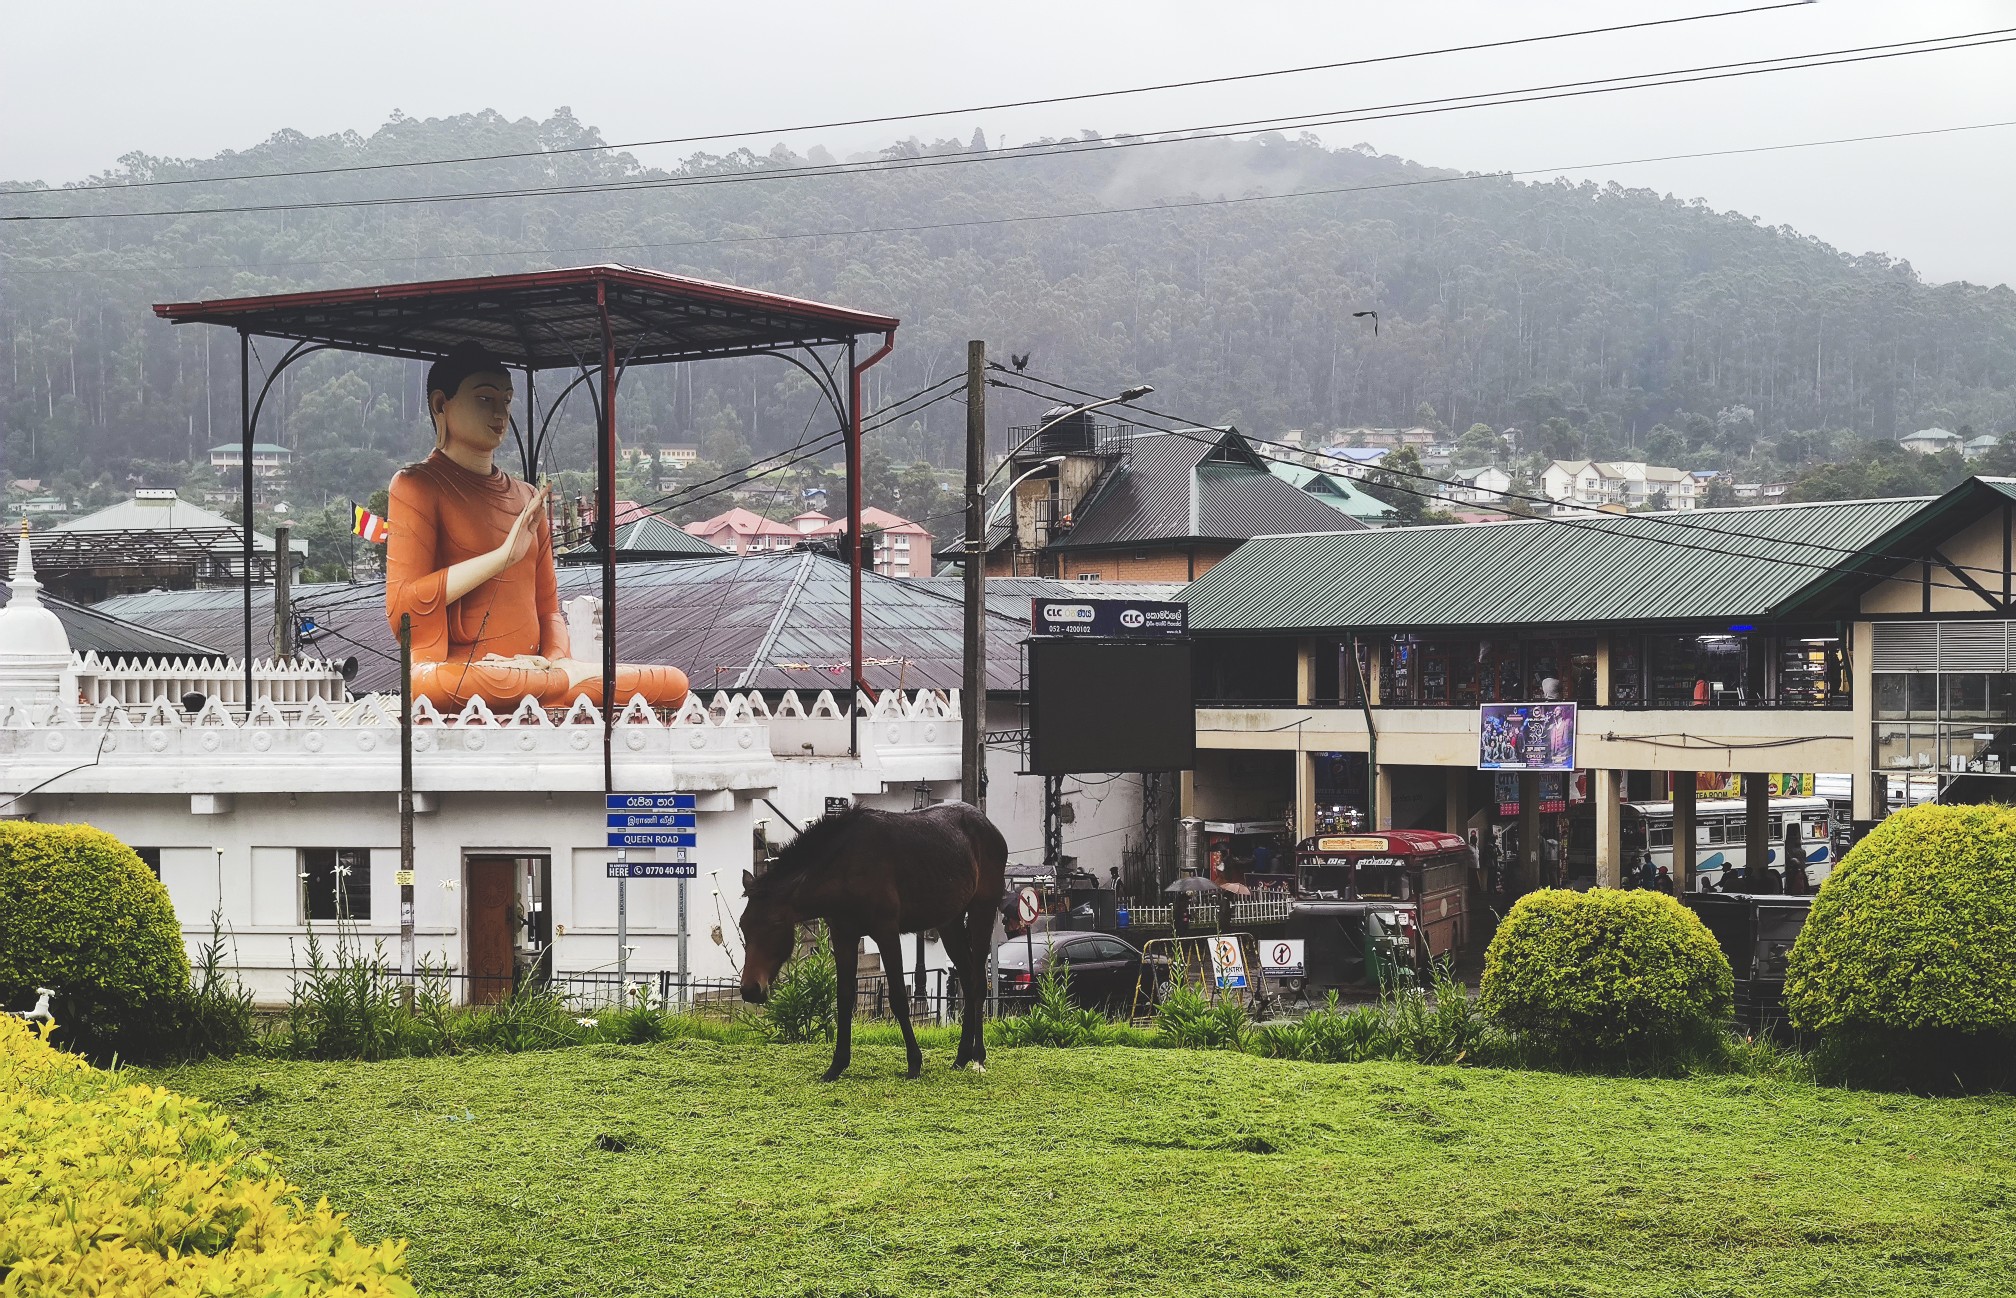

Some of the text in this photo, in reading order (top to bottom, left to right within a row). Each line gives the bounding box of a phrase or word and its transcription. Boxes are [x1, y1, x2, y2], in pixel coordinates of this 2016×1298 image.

[1046, 608, 1062, 617] CLC
[1122, 613, 1142, 624] CLC
[1048, 625, 1060, 633] 052
[1066, 625, 1091, 633] 4200102
[657, 797, 675, 806] පාර
[627, 816, 675, 826] இராணி வீதி
[624, 836, 653, 845] QUEEN
[609, 867, 629, 877] HERE
[645, 866, 695, 875] 0770 40 40 10
